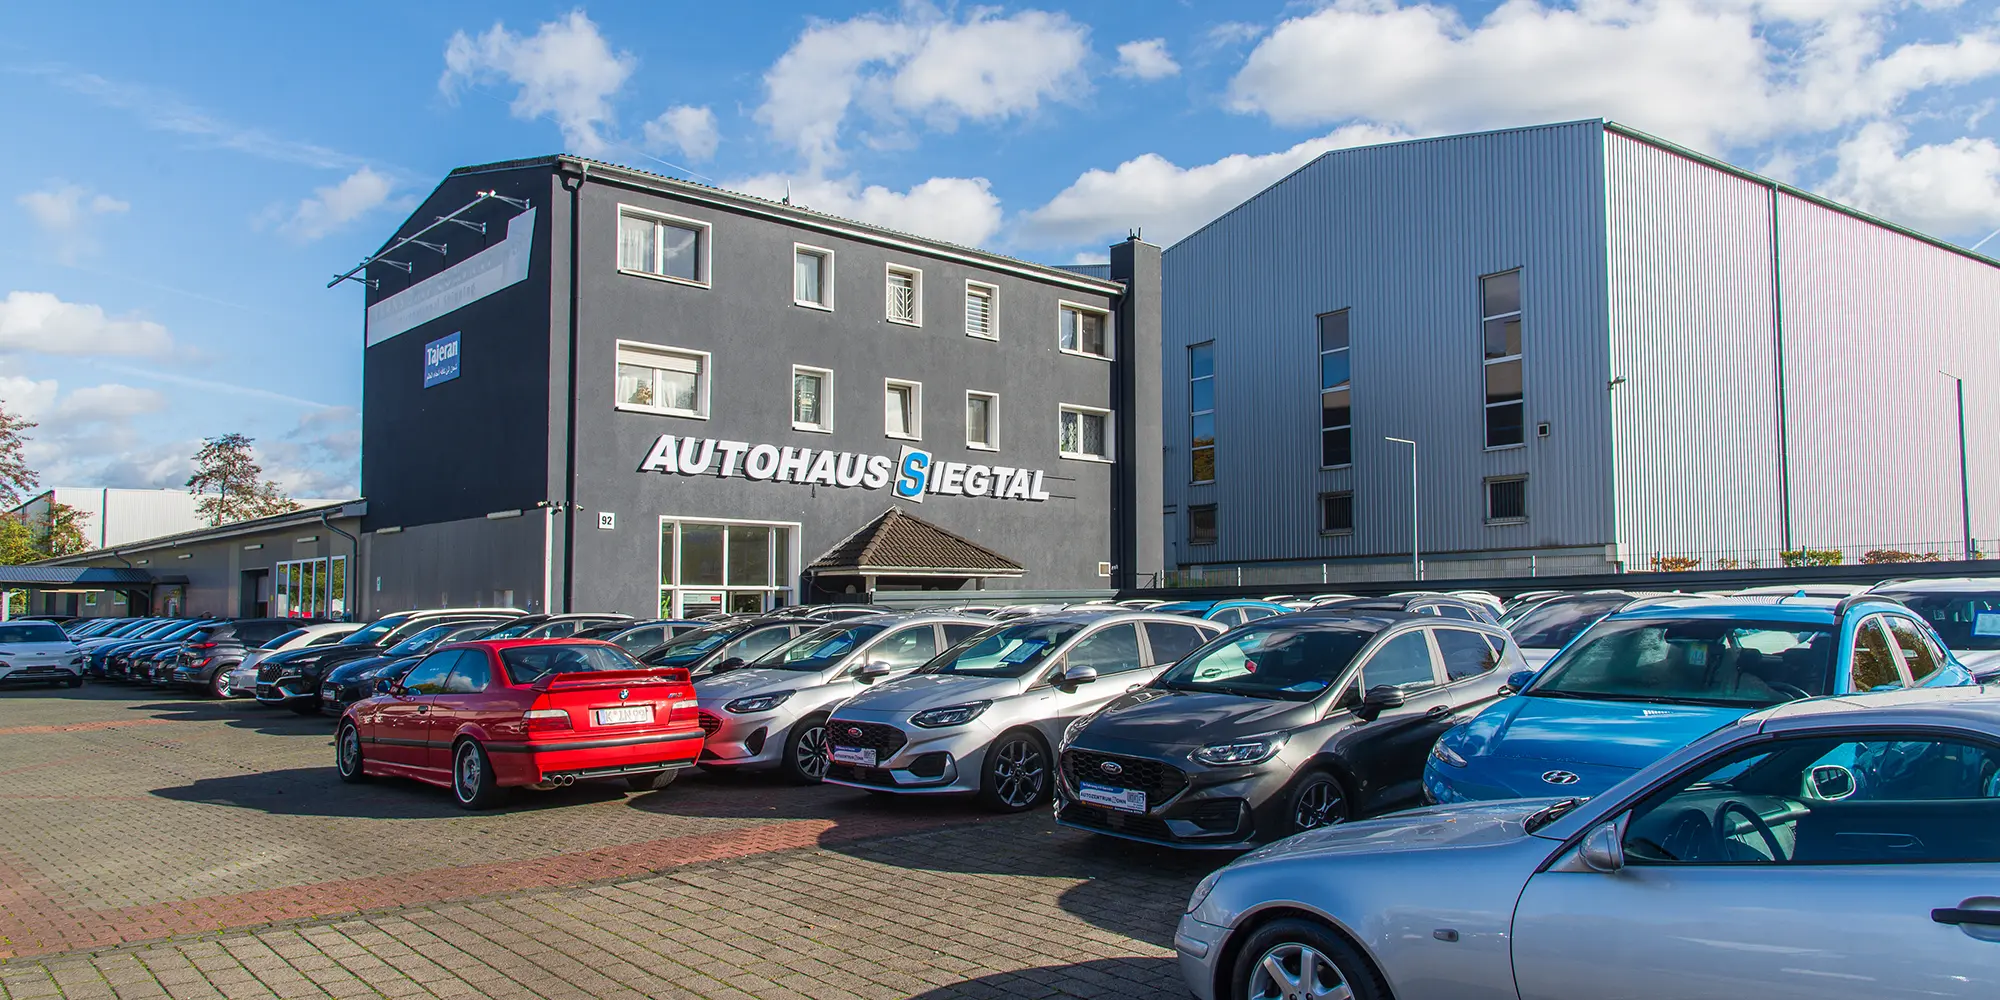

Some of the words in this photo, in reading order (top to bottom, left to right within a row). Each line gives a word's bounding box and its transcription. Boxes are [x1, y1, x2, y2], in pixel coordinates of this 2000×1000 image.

[427, 340, 458, 367] Tajeran
[641, 433, 892, 490] AUTOHAUS
[899, 451, 1050, 501] SIEGTAL
[601, 515, 613, 526] 92
